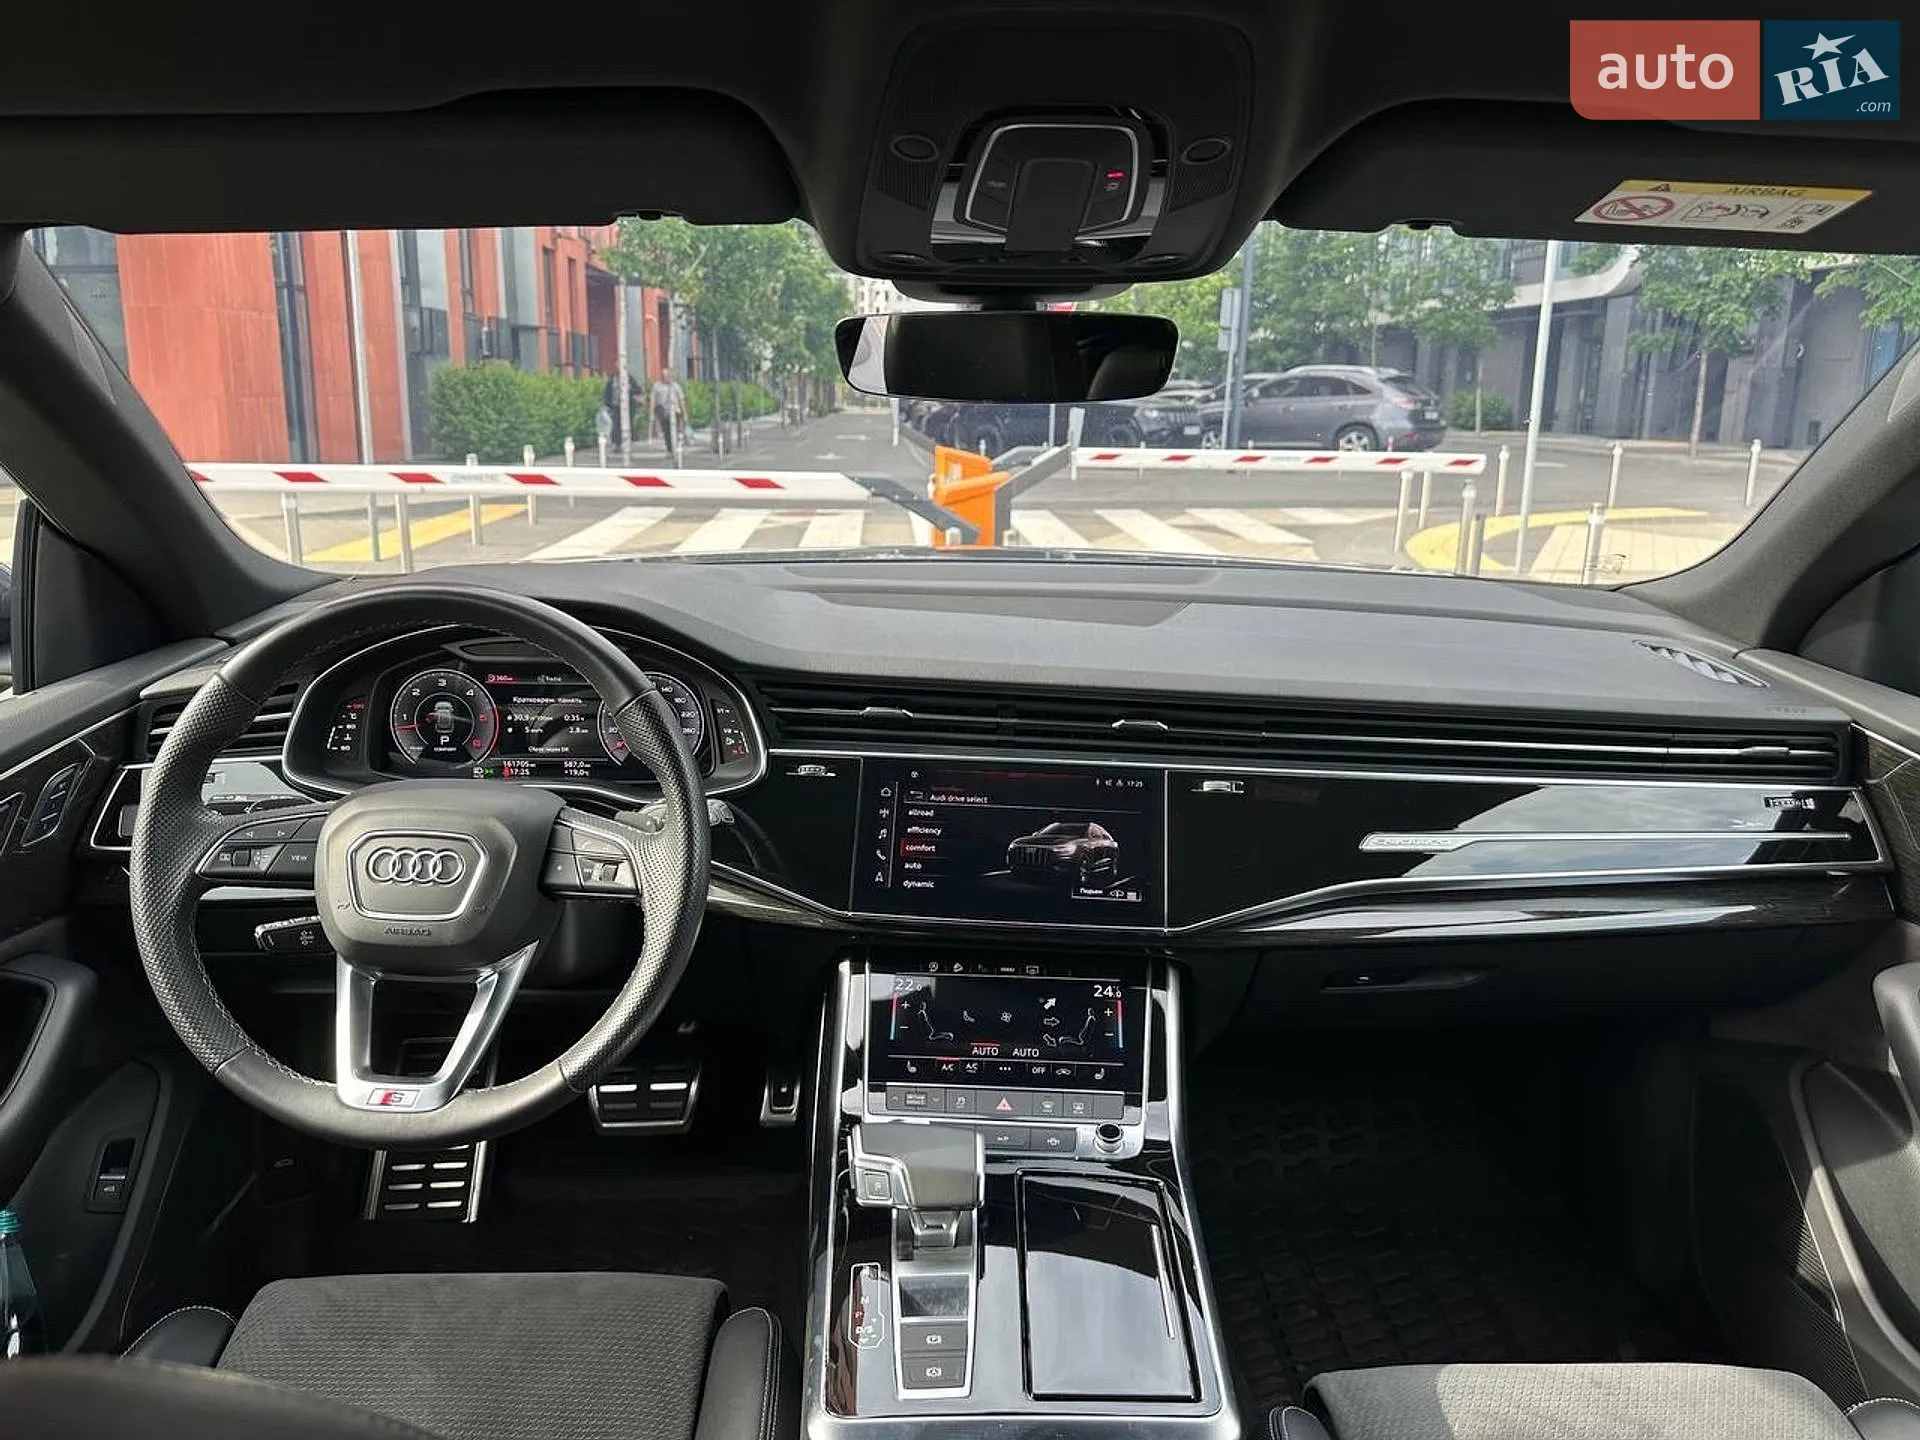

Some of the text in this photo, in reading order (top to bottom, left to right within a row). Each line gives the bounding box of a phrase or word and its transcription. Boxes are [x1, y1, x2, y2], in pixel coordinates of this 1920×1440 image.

[1725, 187, 1807, 197] AIRBAG
[437, 679, 448, 687] 3
[412, 689, 422, 697] 2
[466, 689, 475, 697] 4
[440, 736, 450, 746] P
[930, 794, 988, 804] Audi drive select
[908, 809, 934, 817] allroad
[907, 826, 942, 836] efficiency
[905, 844, 936, 853] comfort
[904, 862, 922, 870] auto
[903, 880, 935, 890] dynamic
[385, 928, 432, 937] AIRBAG
[972, 1047, 999, 1057] AUTO
[1012, 1048, 1039, 1058] AUTO
[1031, 1066, 1046, 1074] OFF
